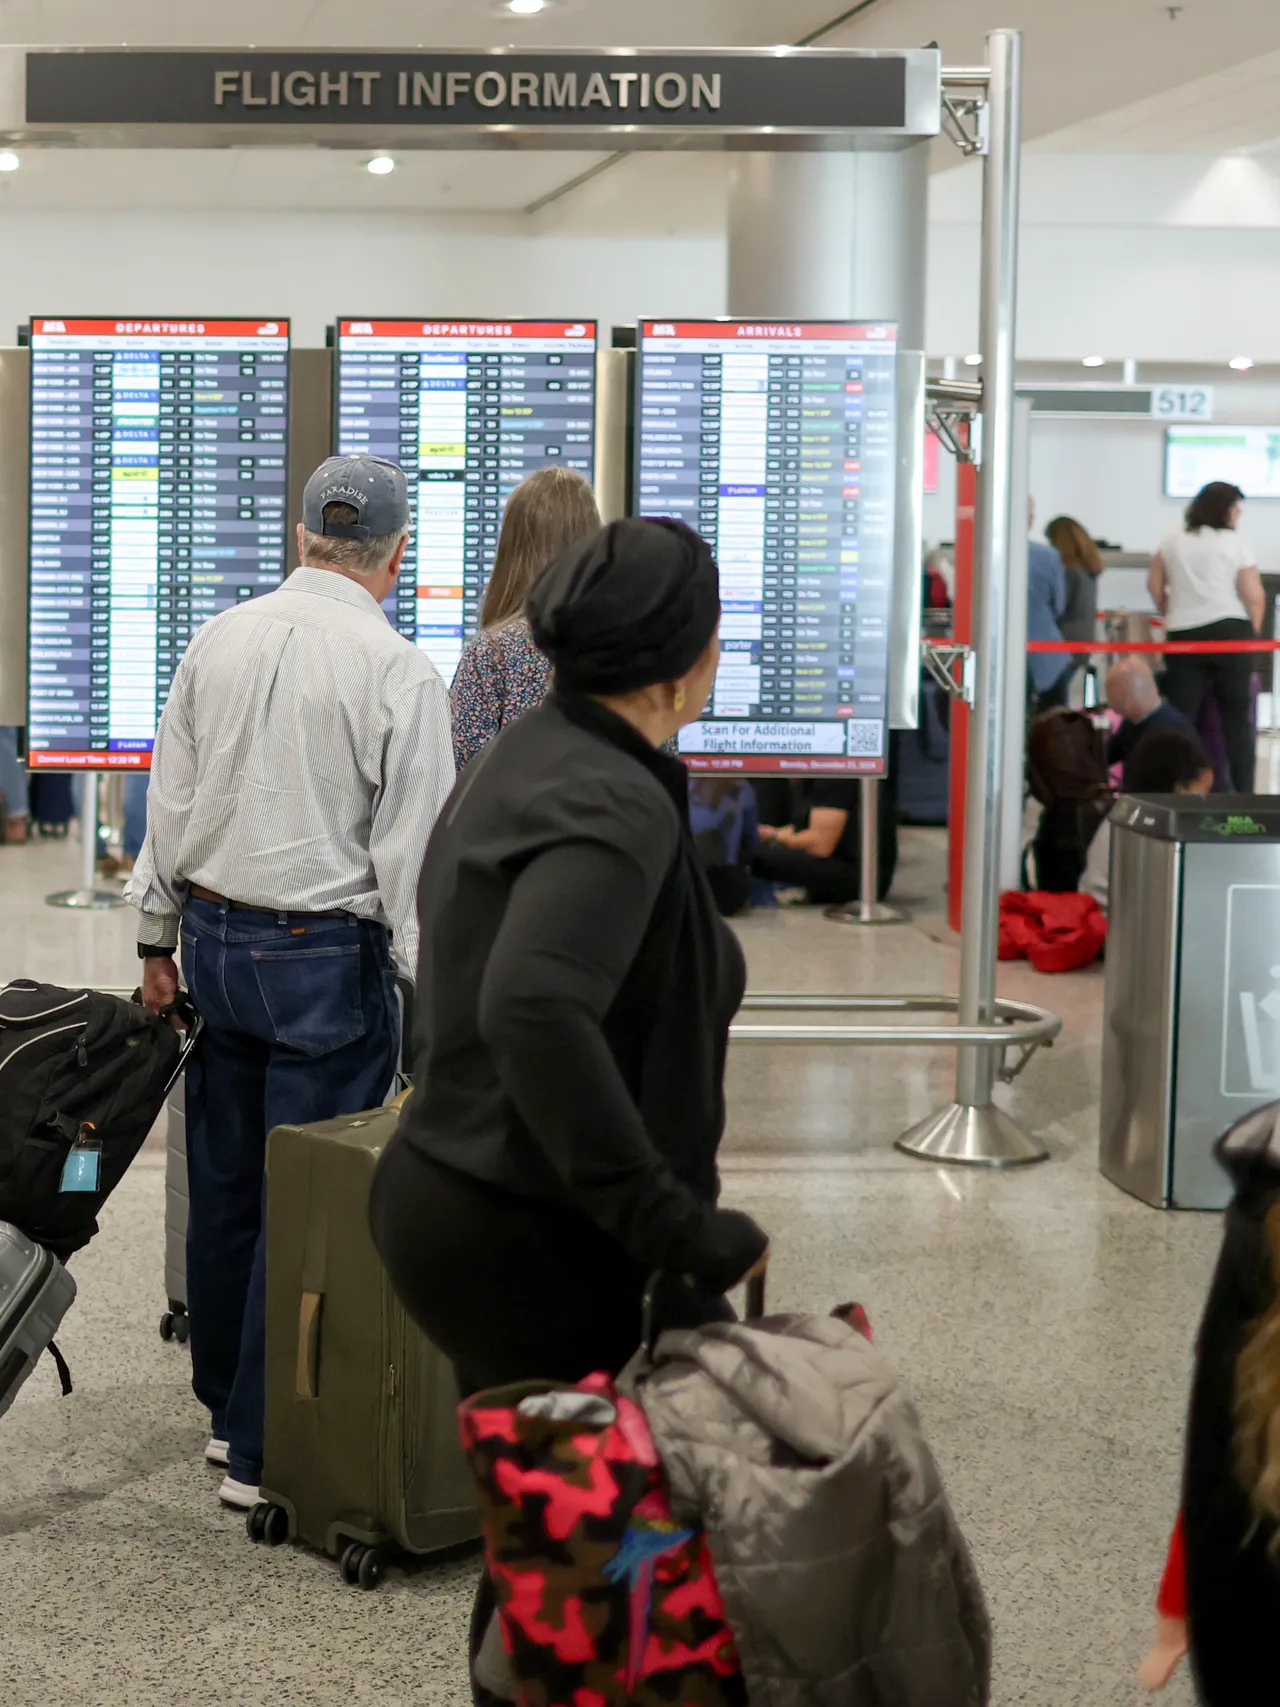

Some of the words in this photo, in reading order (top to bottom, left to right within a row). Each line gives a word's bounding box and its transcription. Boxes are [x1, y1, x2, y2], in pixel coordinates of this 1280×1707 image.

[212, 69, 381, 107] FLIGHT
[396, 70, 724, 110] INFORMATION
[115, 323, 206, 334] DEPARTURES
[422, 324, 513, 336] DEPARTURES
[736, 326, 803, 338] ARRIVALS
[123, 352, 149, 360] DELTA
[123, 391, 149, 399] DELTA
[1158, 391, 1206, 415] 512
[122, 430, 149, 438] DELTA
[122, 456, 149, 465] DELTA
[320, 485, 369, 505] PARADISE
[701, 724, 729, 736] Scan
[732, 724, 751, 736] For
[754, 724, 816, 736] Additional
[703, 738, 737, 753] Flight
[740, 739, 812, 751] Information
